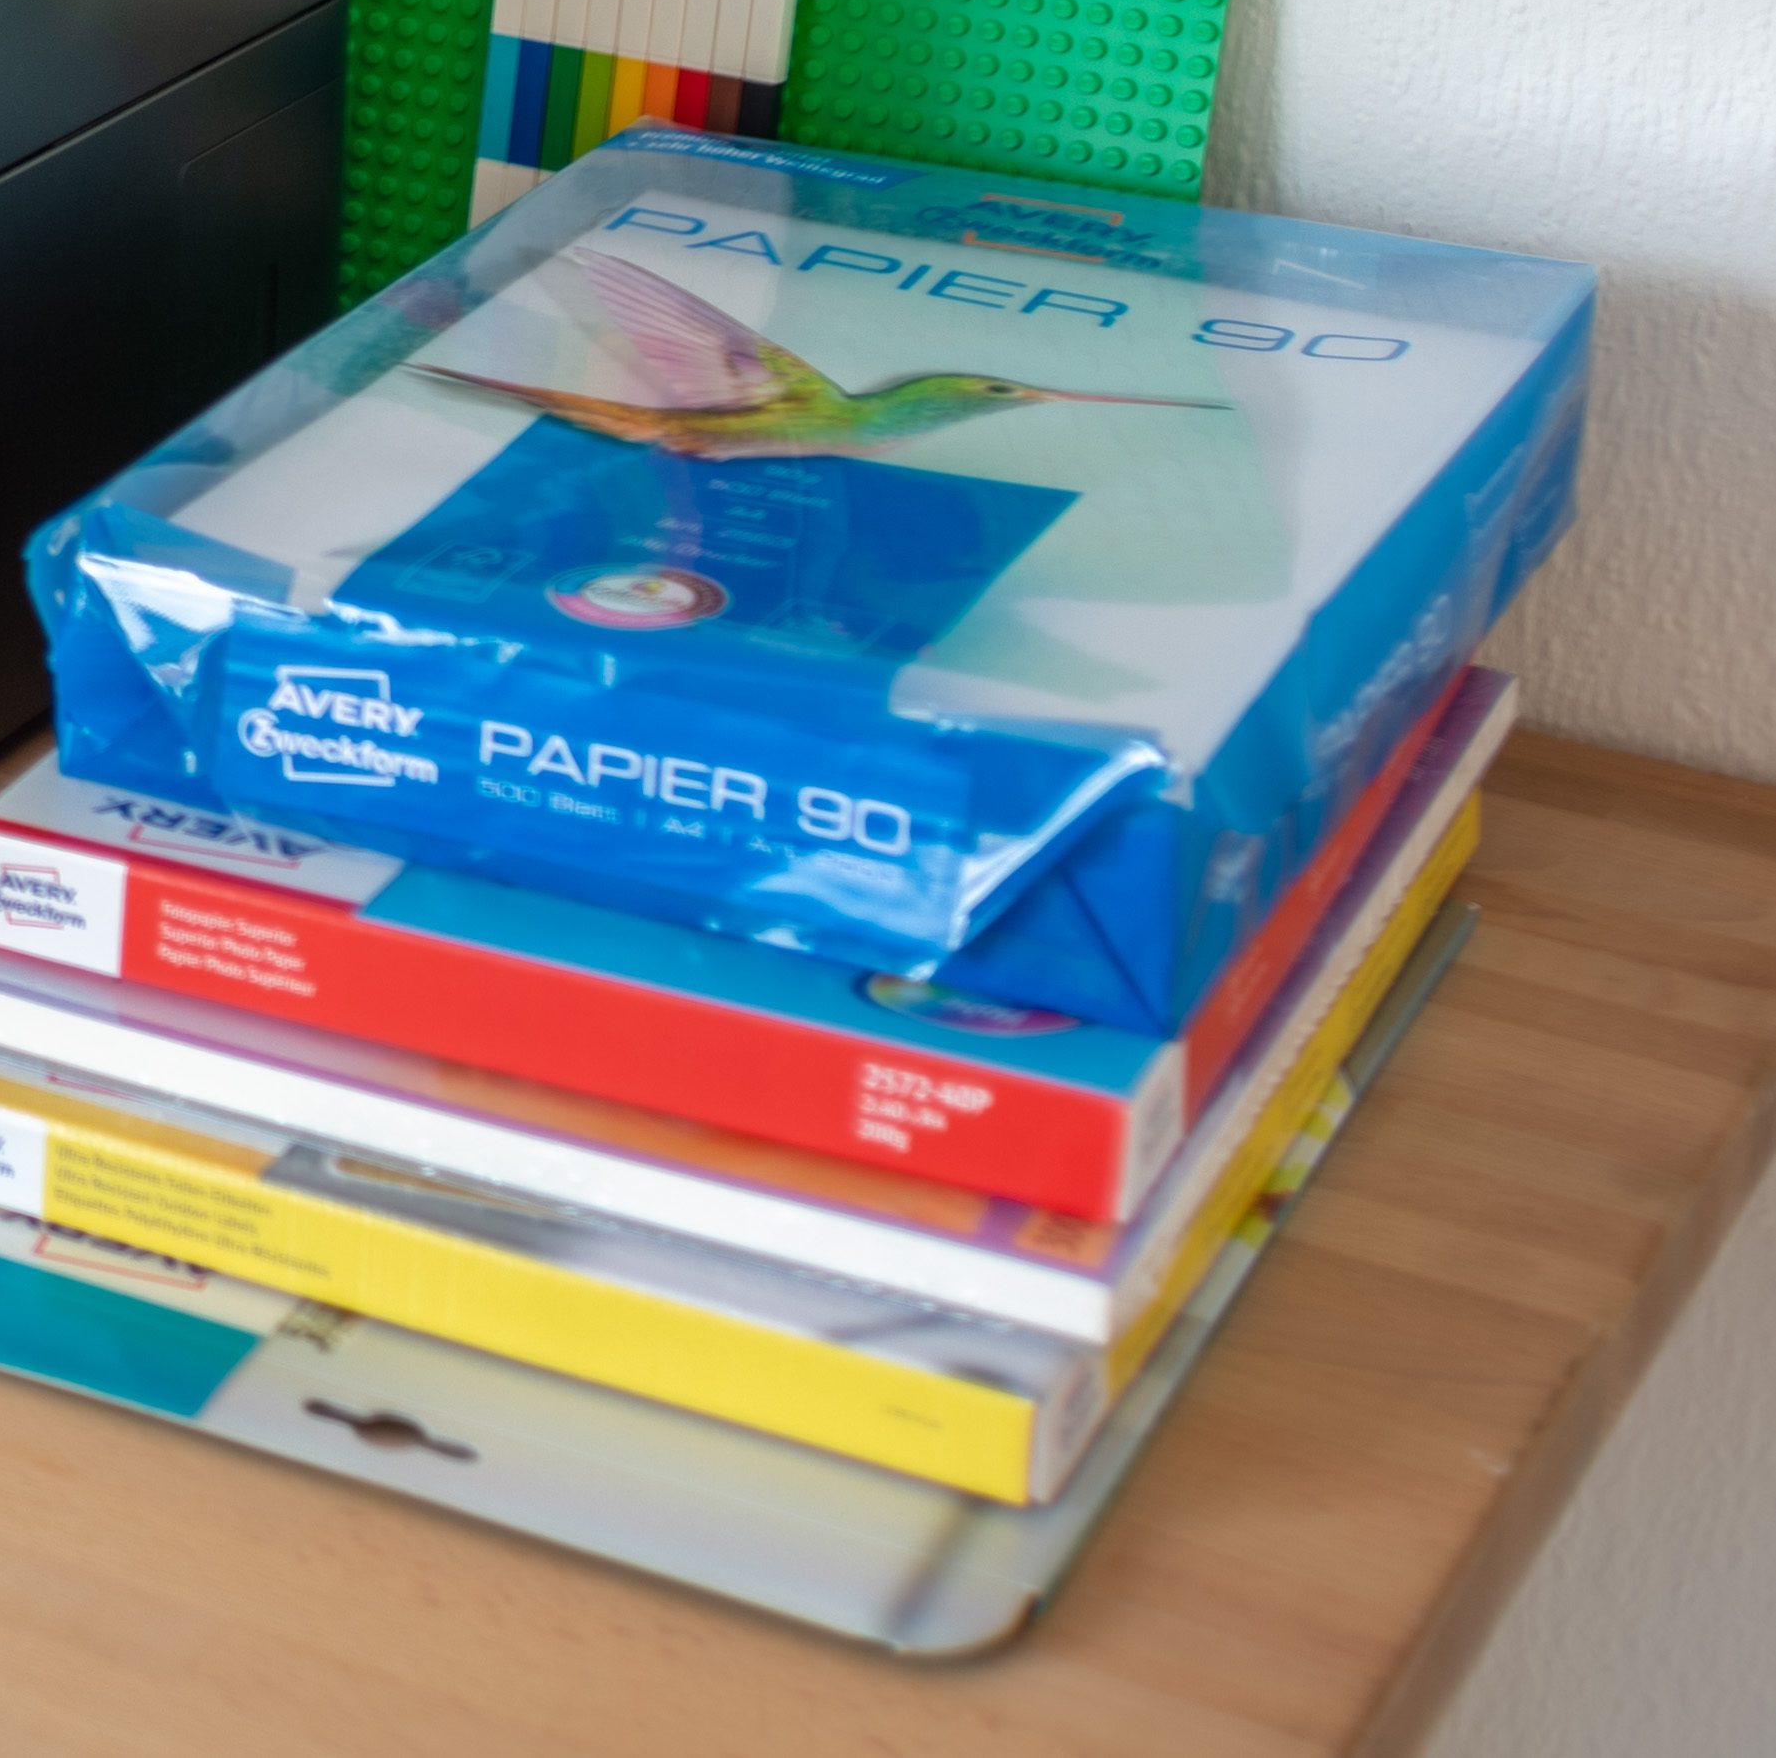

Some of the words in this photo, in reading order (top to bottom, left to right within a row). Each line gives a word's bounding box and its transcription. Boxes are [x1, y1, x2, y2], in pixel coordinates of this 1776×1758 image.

[697, 143, 761, 162] hoher
[964, 199, 1155, 246] AVERY
[603, 206, 1130, 329] PAPIER
[1190, 317, 1411, 362] 90
[267, 680, 426, 738] AVERY
[240, 710, 439, 785] Zweckform
[477, 775, 542, 808] 500
[478, 719, 769, 821] PAPIER
[796, 785, 913, 857] 90
[92, 795, 329, 860] AVERY
[662, 815, 706, 839] A4
[159, 921, 219, 950] Superior
[221, 936, 263, 962] Photo
[264, 946, 307, 973] Paper
[236, 917, 298, 948] Superior
[157, 941, 203, 969] Papier
[204, 953, 246, 980] Photo
